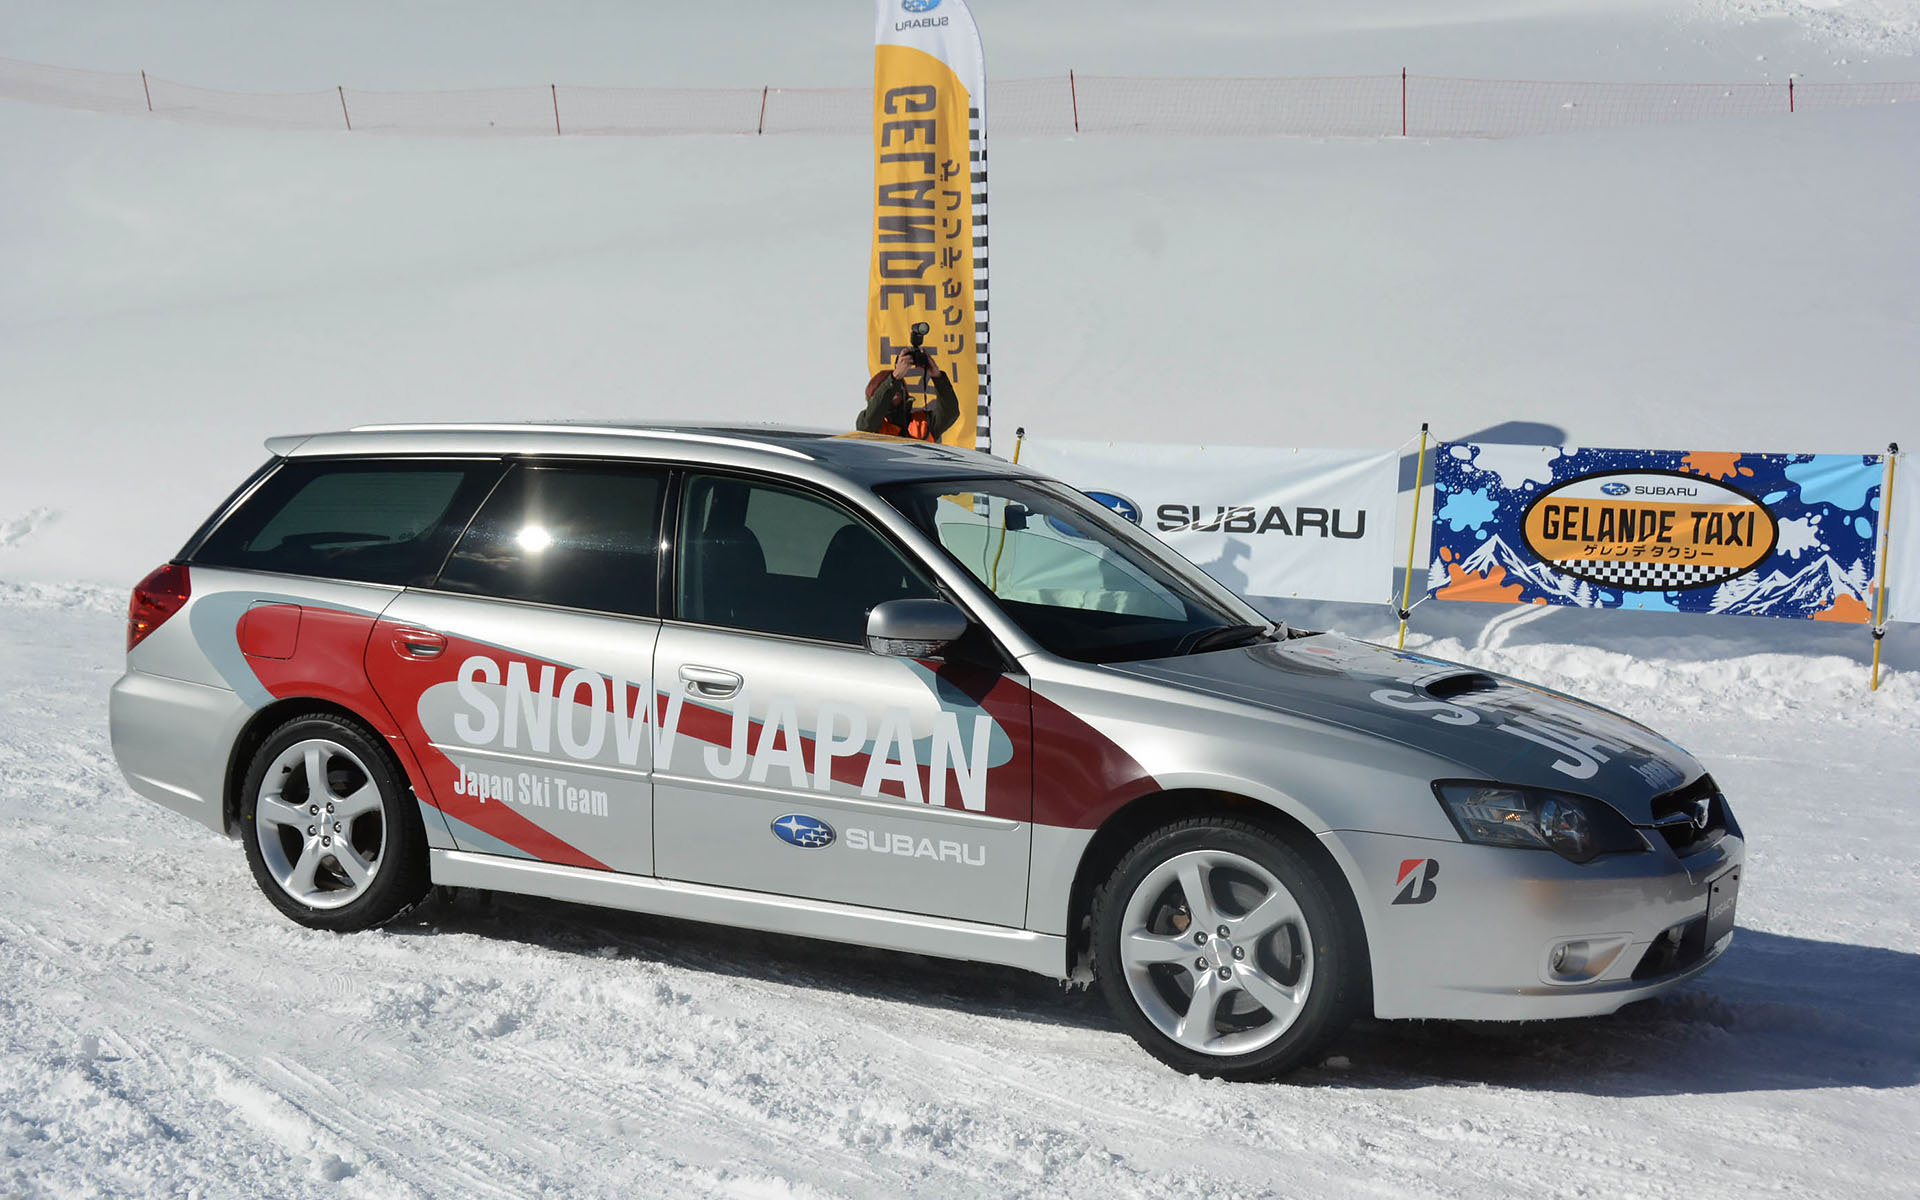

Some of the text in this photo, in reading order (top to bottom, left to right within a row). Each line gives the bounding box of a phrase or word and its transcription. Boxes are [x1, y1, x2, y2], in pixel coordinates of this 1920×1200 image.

[1634, 485, 1698, 497] SUBARU
[1157, 504, 1366, 539] SUBARU
[1543, 504, 1755, 547] GELANDE TAXI
[1584, 545, 1714, 559] ゲレンデタクシー
[454, 655, 992, 812] SNOW JAPAN
[454, 763, 609, 817] Japan Ski Team
[845, 828, 986, 867] SUBARU
